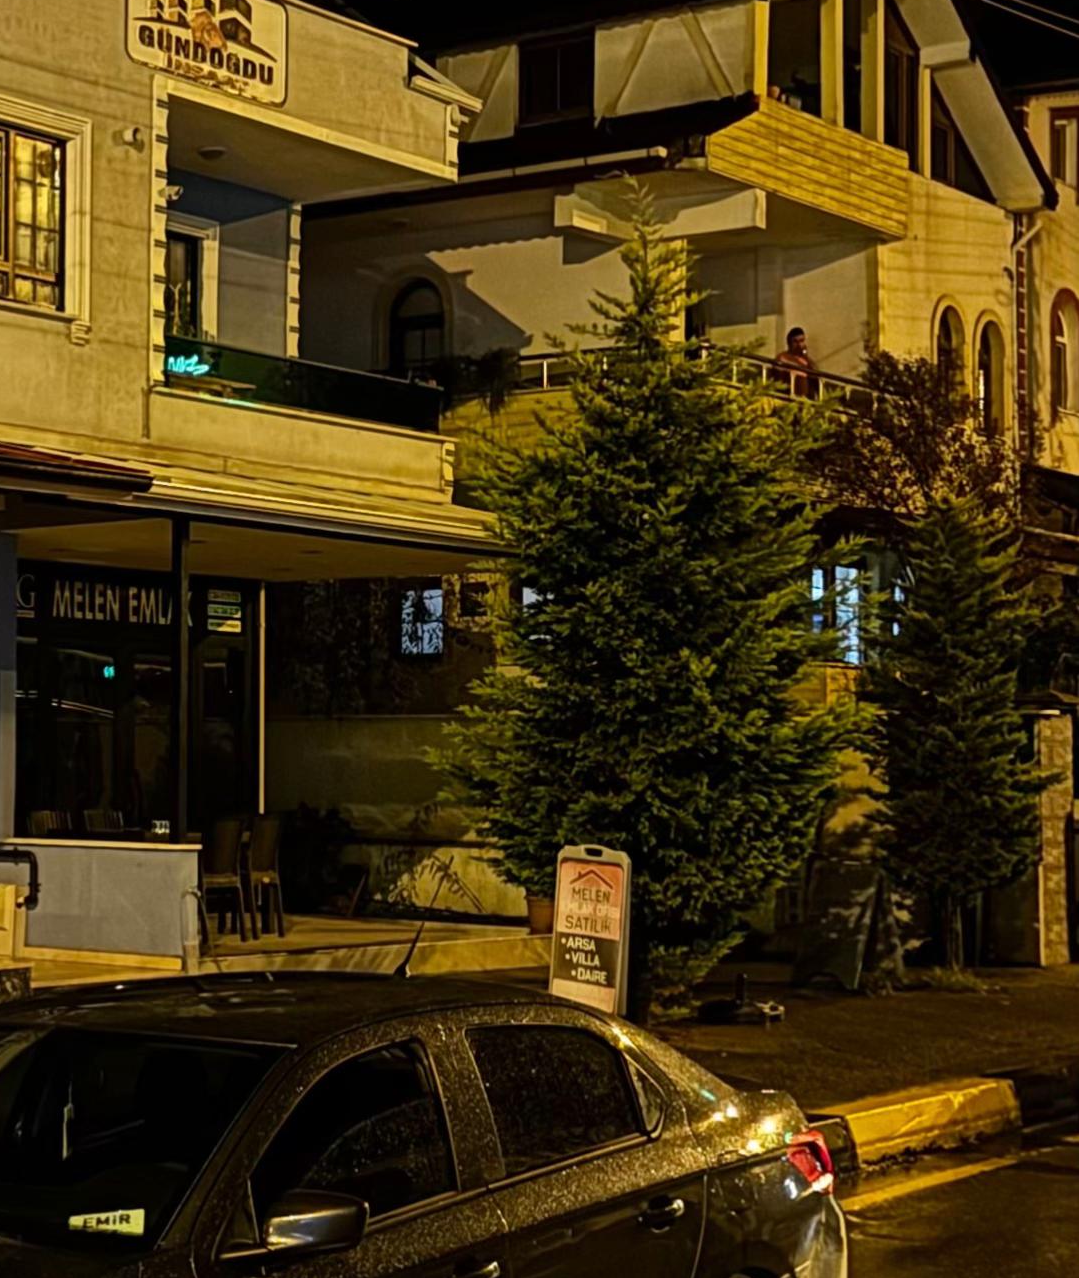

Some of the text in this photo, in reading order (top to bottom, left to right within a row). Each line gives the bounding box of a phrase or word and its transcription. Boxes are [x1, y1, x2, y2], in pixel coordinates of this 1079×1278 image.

[53, 580, 120, 621] MELEN
[572, 887, 611, 904] MELEN
[565, 915, 611, 934] SATILIK
[567, 935, 596, 952] ARSA
